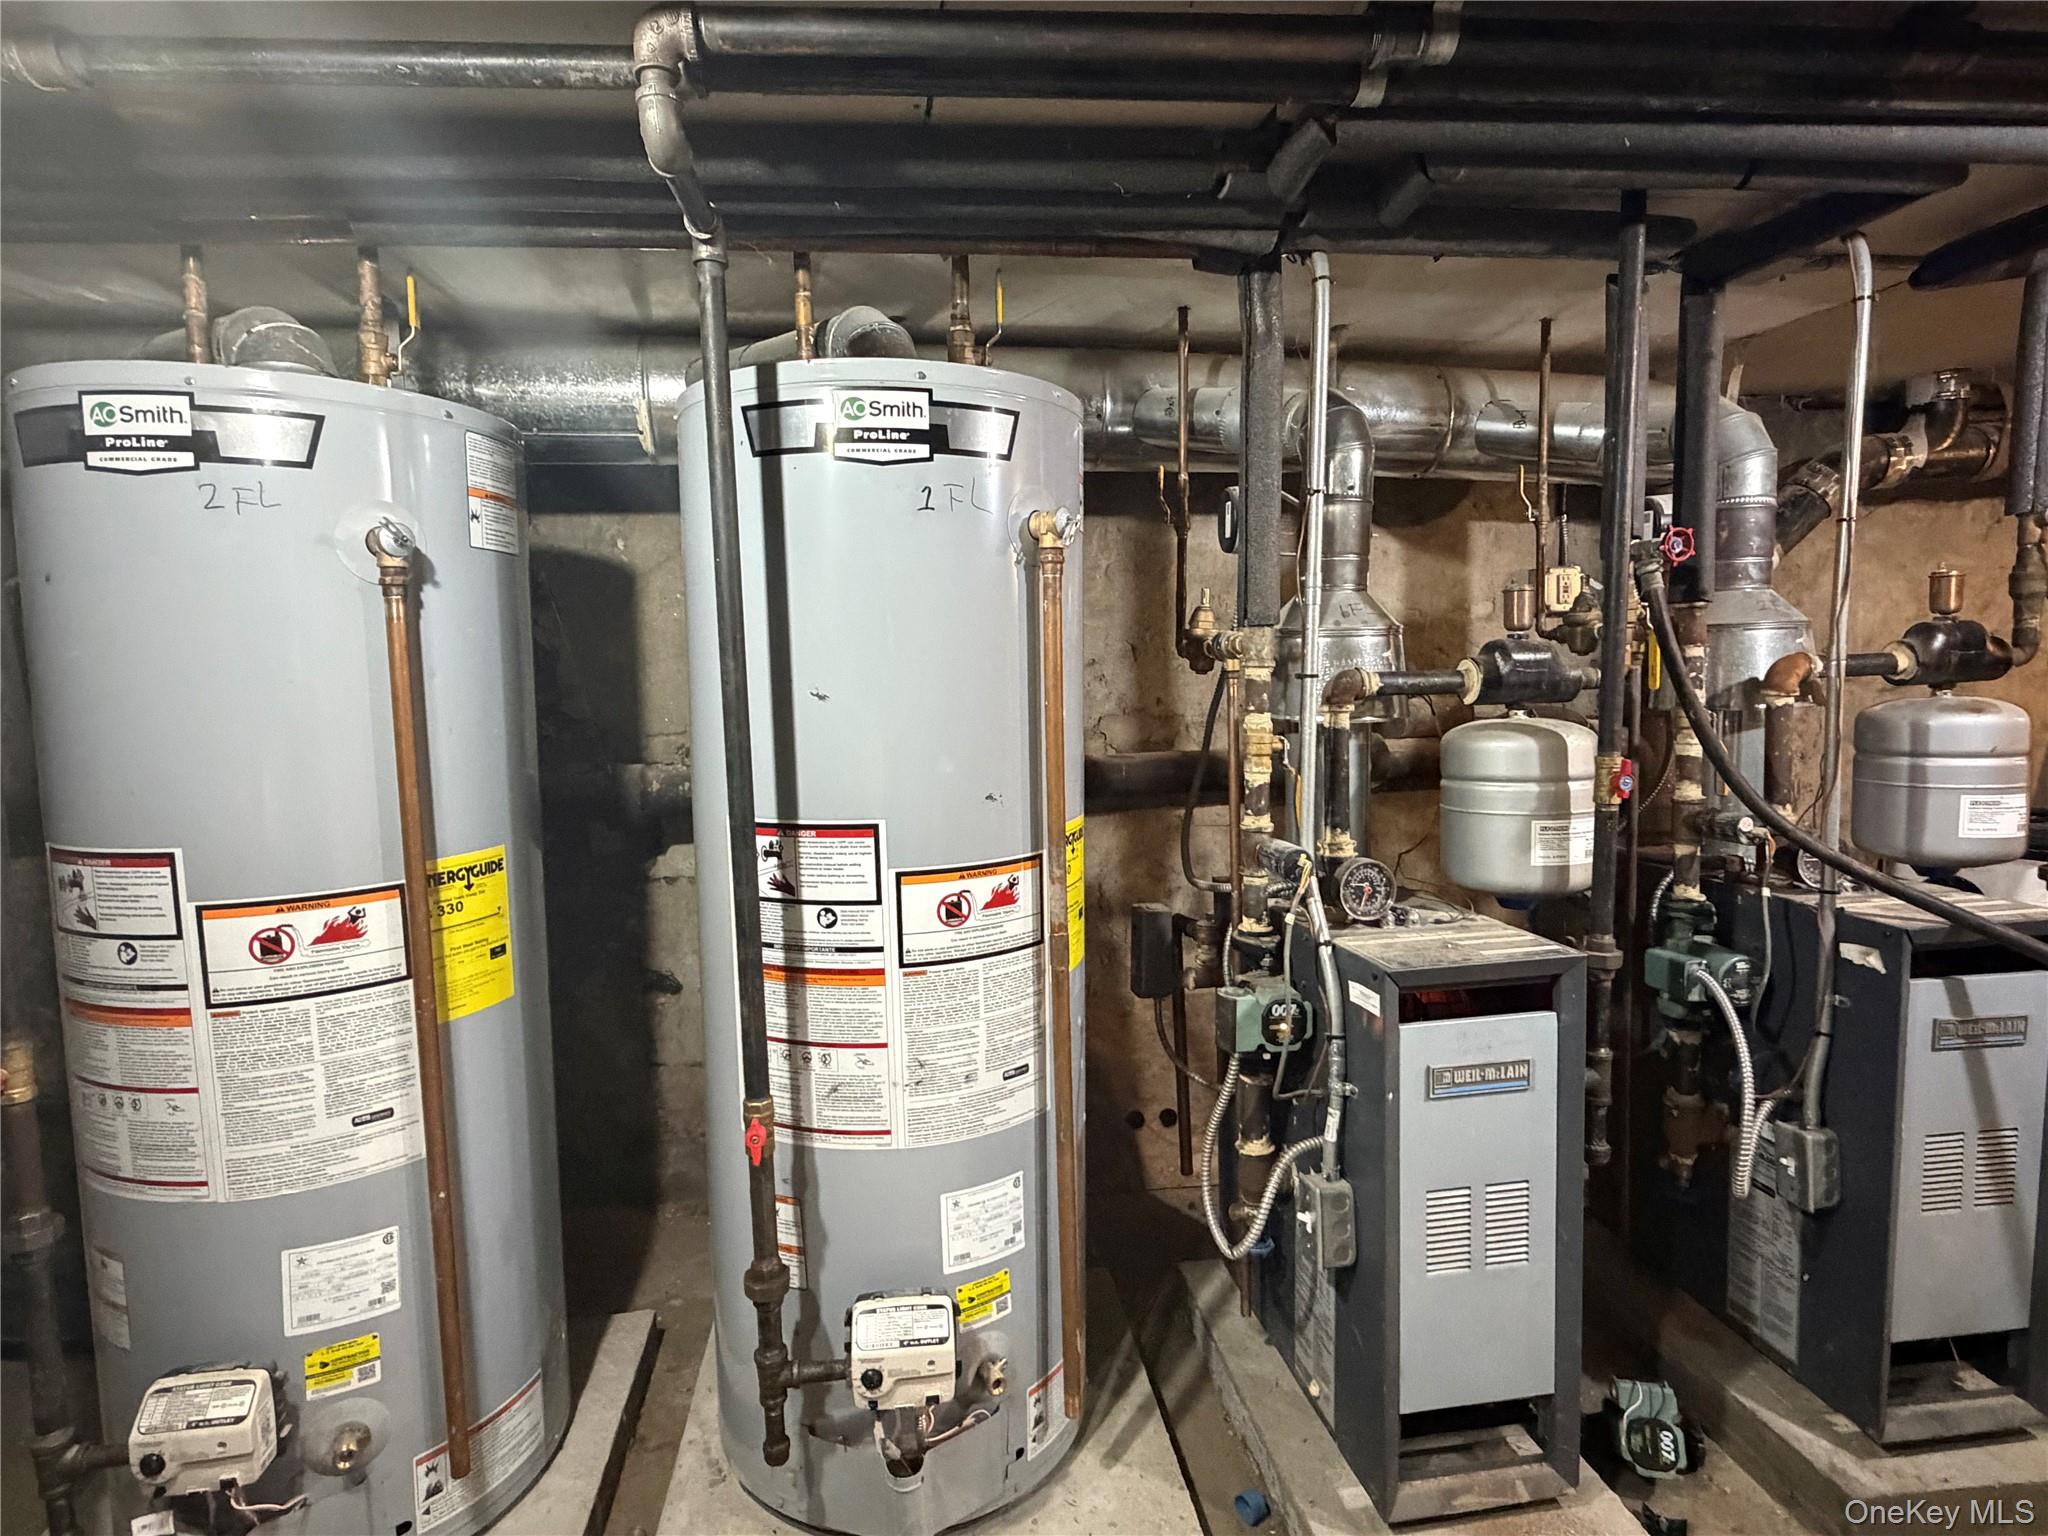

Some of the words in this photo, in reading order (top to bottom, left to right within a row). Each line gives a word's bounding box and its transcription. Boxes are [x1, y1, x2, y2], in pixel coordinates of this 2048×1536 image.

[198, 483, 225, 509] 2
[786, 829, 817, 837] DANGER
[967, 869, 998, 878] WARNING
[286, 900, 331, 913] WARNING
[437, 900, 464, 917] 330
